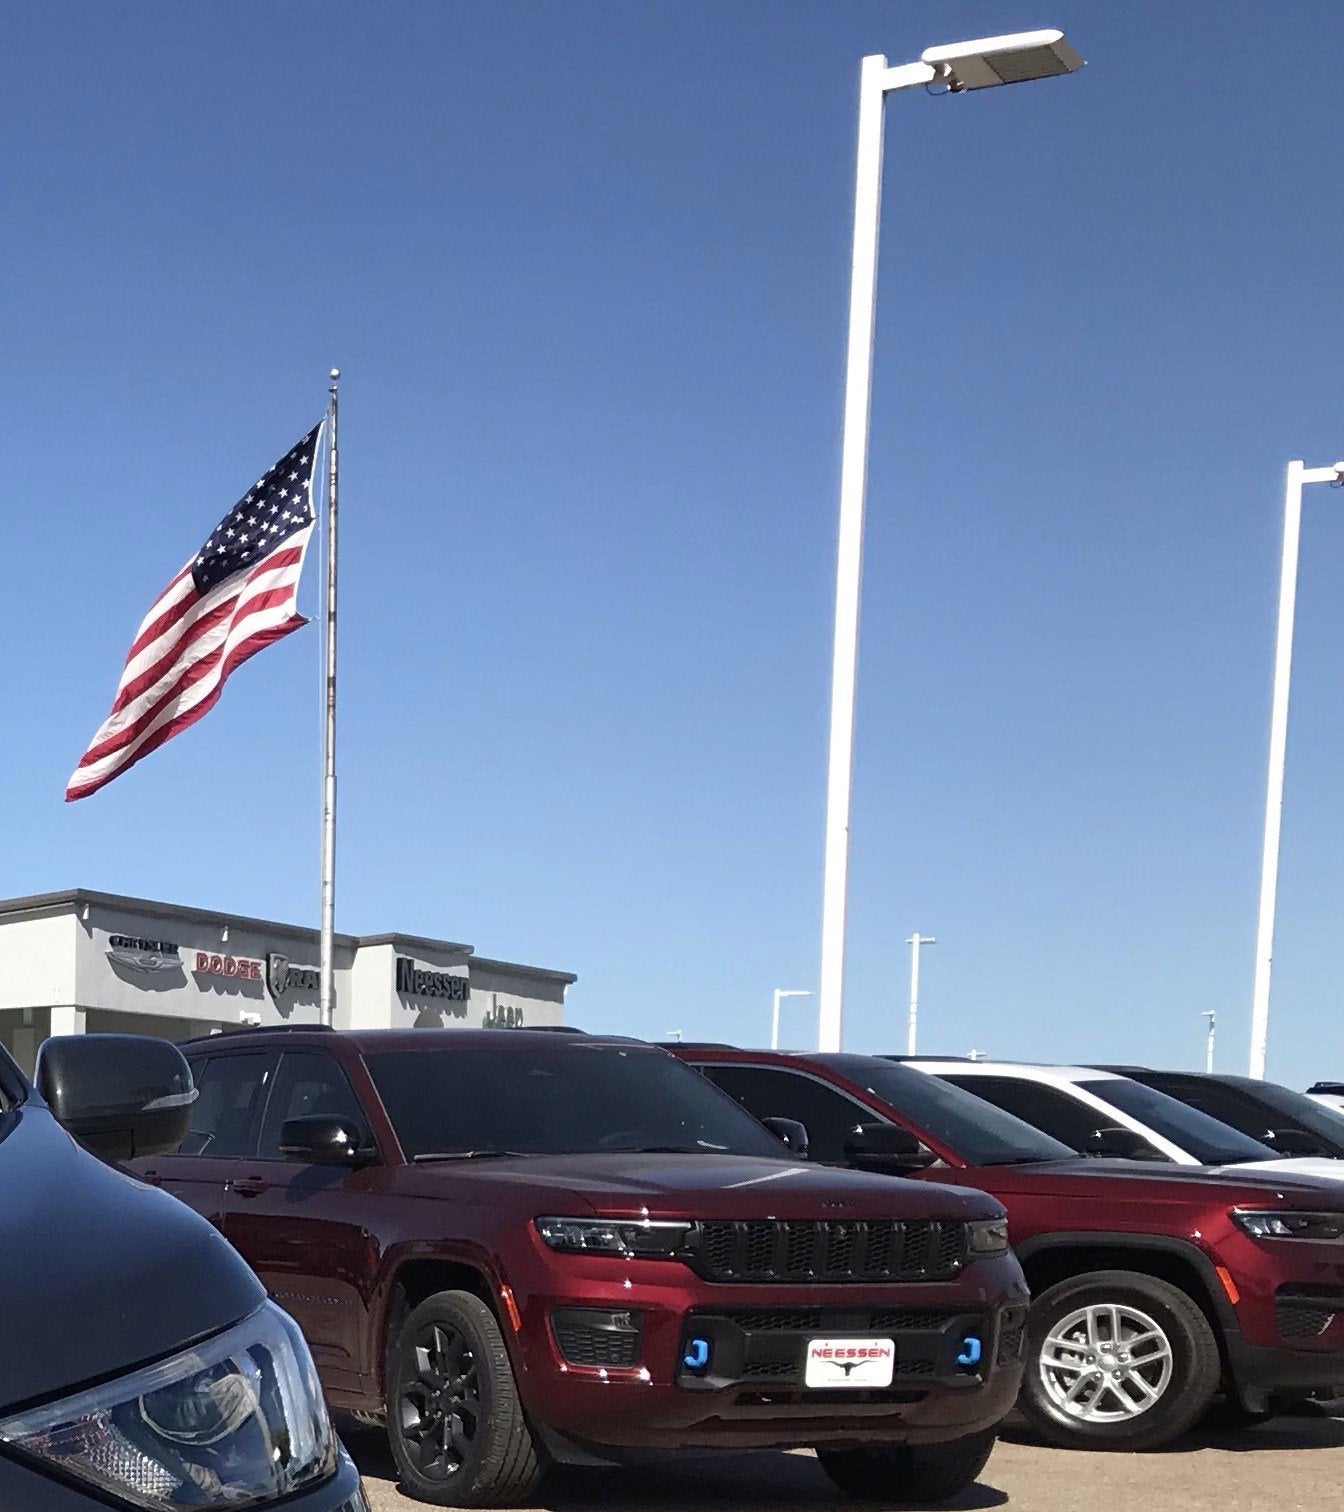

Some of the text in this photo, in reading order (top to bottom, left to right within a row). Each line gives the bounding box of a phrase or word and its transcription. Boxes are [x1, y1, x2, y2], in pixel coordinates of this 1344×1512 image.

[196, 952, 262, 980] DODGE
[396, 957, 471, 1001] Neessen
[811, 1348, 891, 1359] NEESSEN
